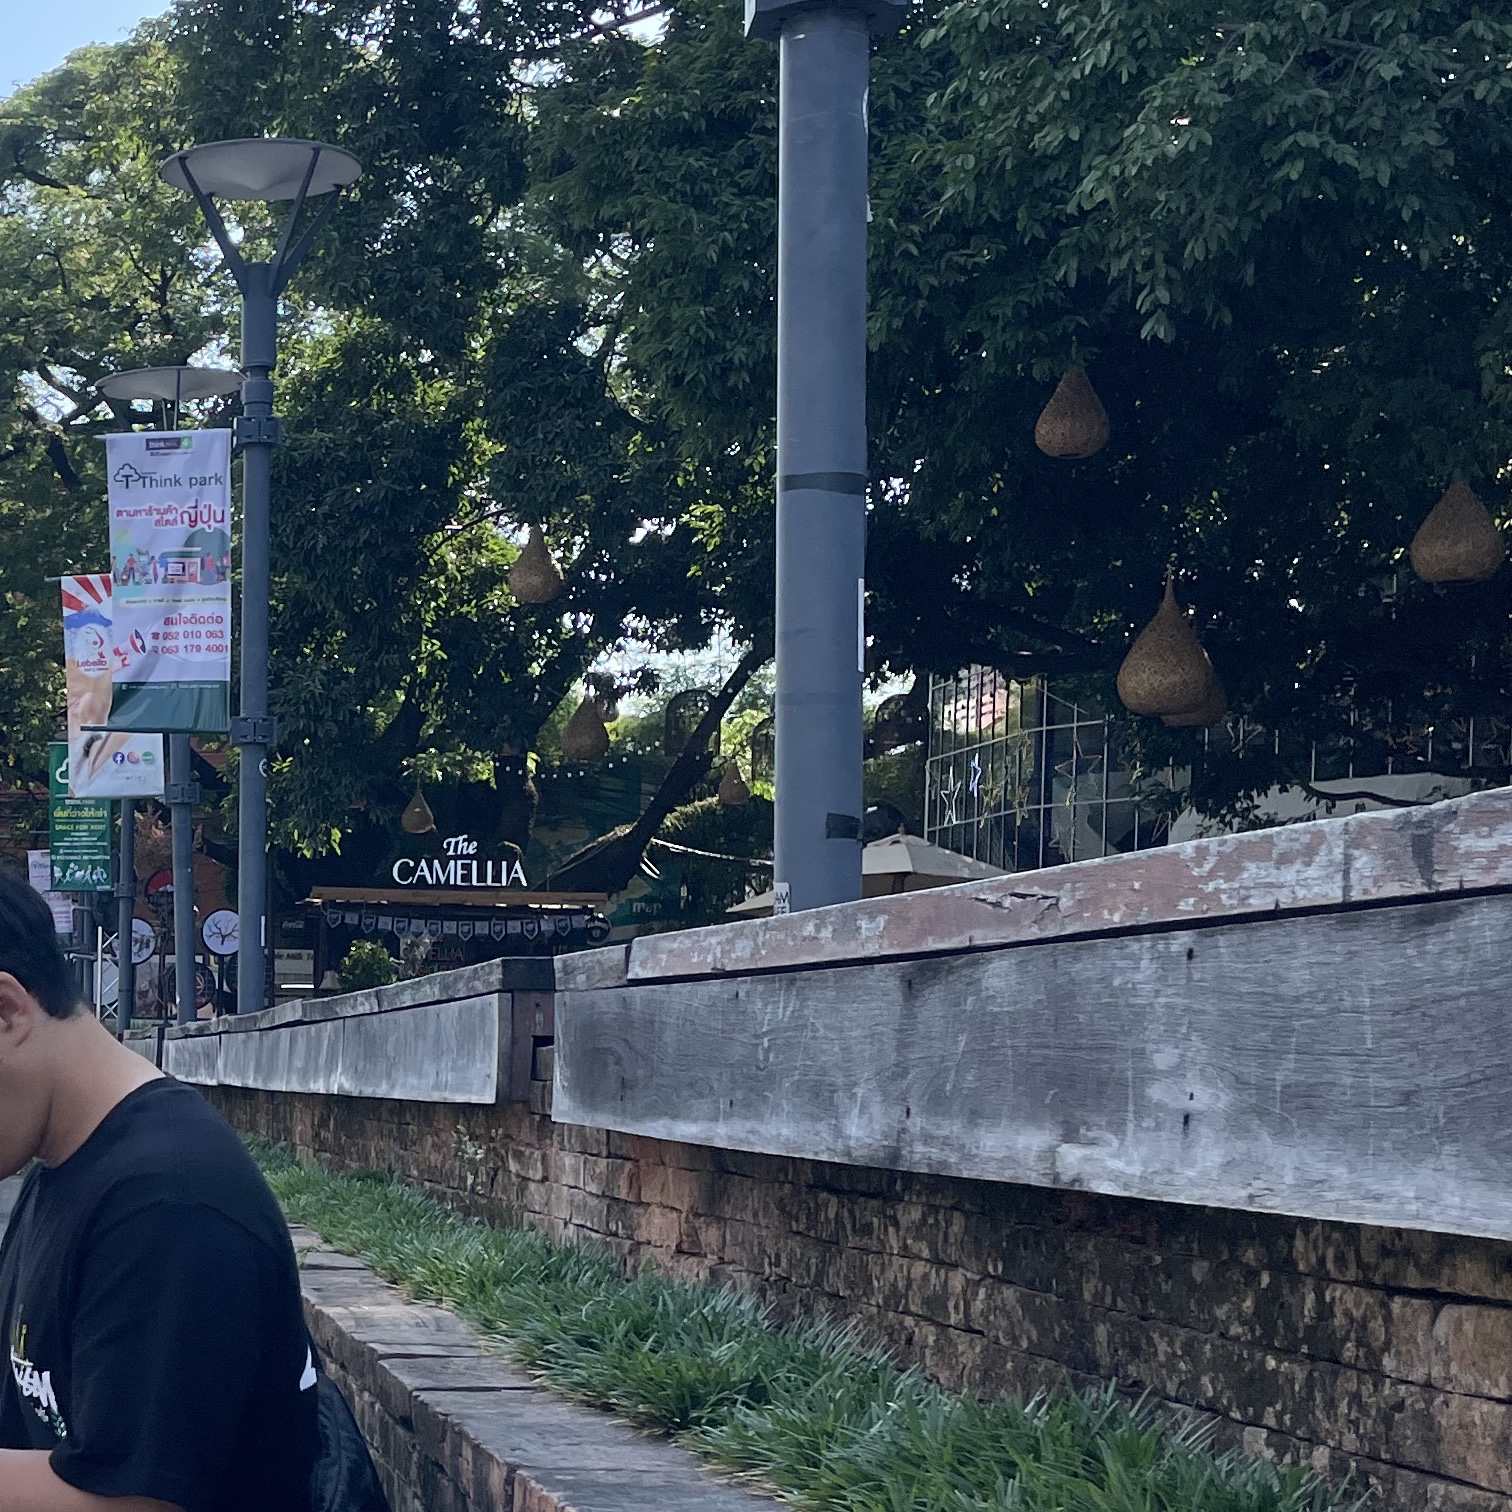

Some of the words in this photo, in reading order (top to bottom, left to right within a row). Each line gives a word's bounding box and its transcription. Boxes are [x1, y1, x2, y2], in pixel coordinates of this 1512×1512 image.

[140, 473, 182, 488] Think
[189, 472, 224, 489] park
[180, 498, 225, 529] ญี่ปุ่น
[163, 612, 223, 626] สนใจติดต่อ
[183, 630, 202, 639] 010
[205, 629, 224, 639] 063
[205, 644, 229, 653] 4001
[443, 834, 478, 856] The
[392, 858, 528, 887] CAMELLIA
